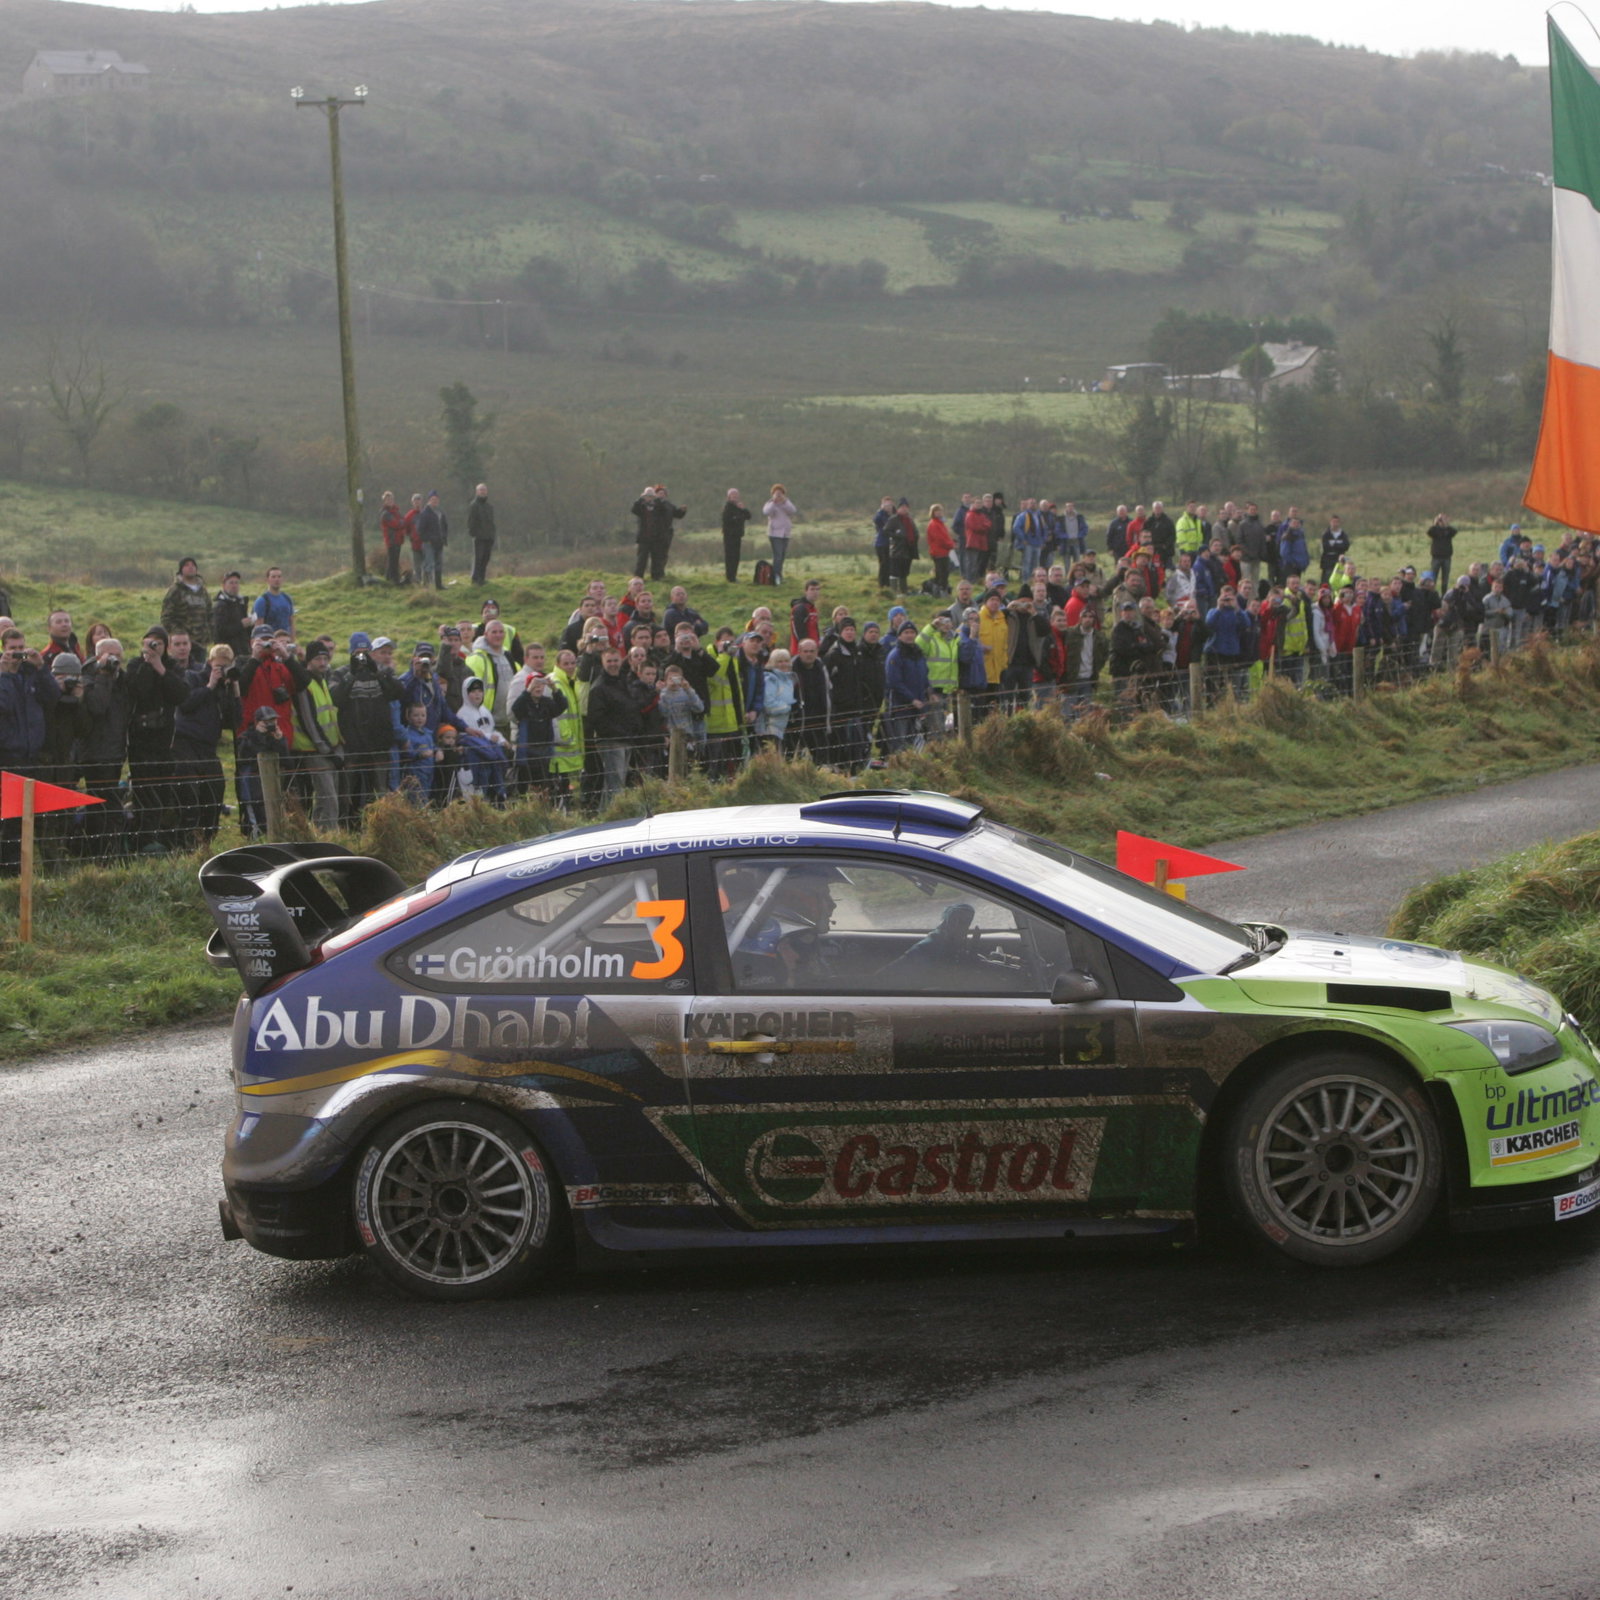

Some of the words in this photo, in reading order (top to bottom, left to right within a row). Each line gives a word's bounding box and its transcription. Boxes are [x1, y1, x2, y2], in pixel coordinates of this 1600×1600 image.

[575, 844, 624, 865] Feel
[632, 838, 670, 854] the
[227, 913, 260, 925] NGK
[630, 899, 686, 980] 3
[450, 947, 624, 979] Grönholm
[254, 996, 387, 1052] Abu
[397, 995, 592, 1050] Dhabi
[684, 1011, 856, 1039] KÄRCHER
[1075, 1023, 1103, 1062] 3
[1485, 1083, 1506, 1101] bp
[1506, 1121, 1580, 1154] KÄRCHER
[832, 1128, 1081, 1200] Castrol
